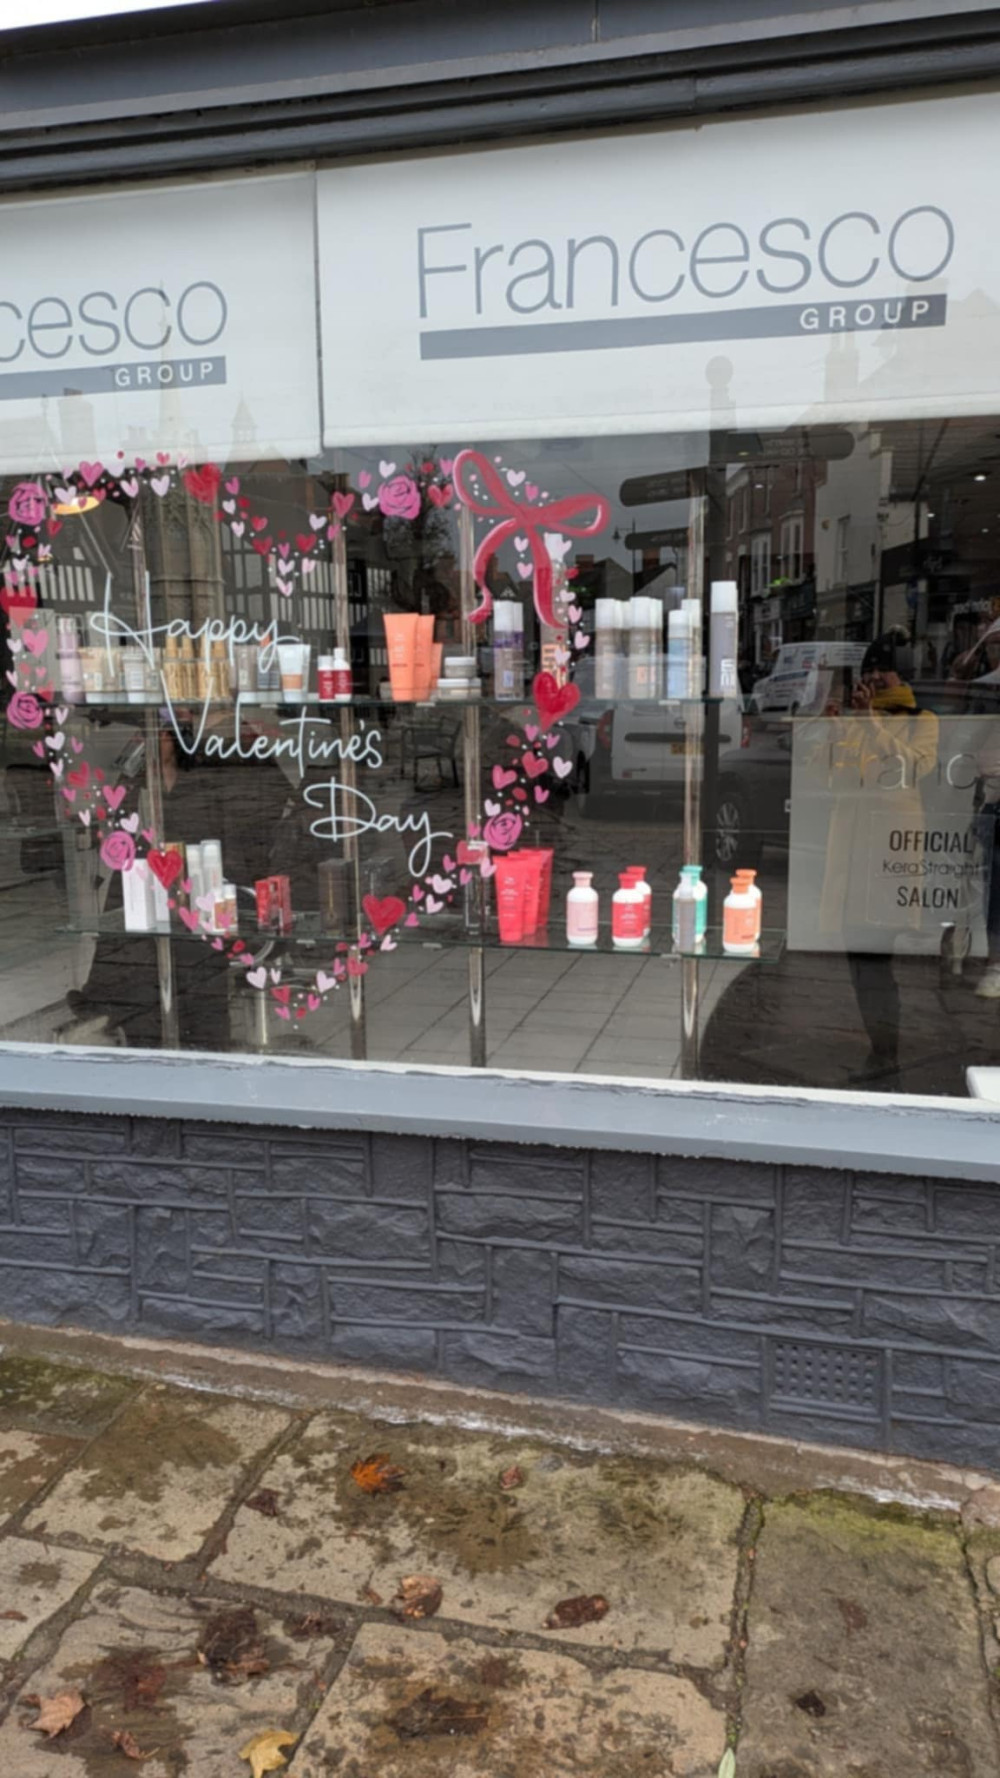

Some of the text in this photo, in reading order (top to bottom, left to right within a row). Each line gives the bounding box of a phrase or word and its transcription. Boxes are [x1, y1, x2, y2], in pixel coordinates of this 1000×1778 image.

[416, 205, 955, 319] Francesco
[799, 300, 930, 331] GROUP
[114, 361, 215, 387] GROUP
[89, 570, 301, 678] Happy
[160, 669, 383, 778] Valentine's
[303, 776, 453, 878] Day
[888, 829, 974, 854] OFFICIAL
[896, 885, 960, 910] SALON
